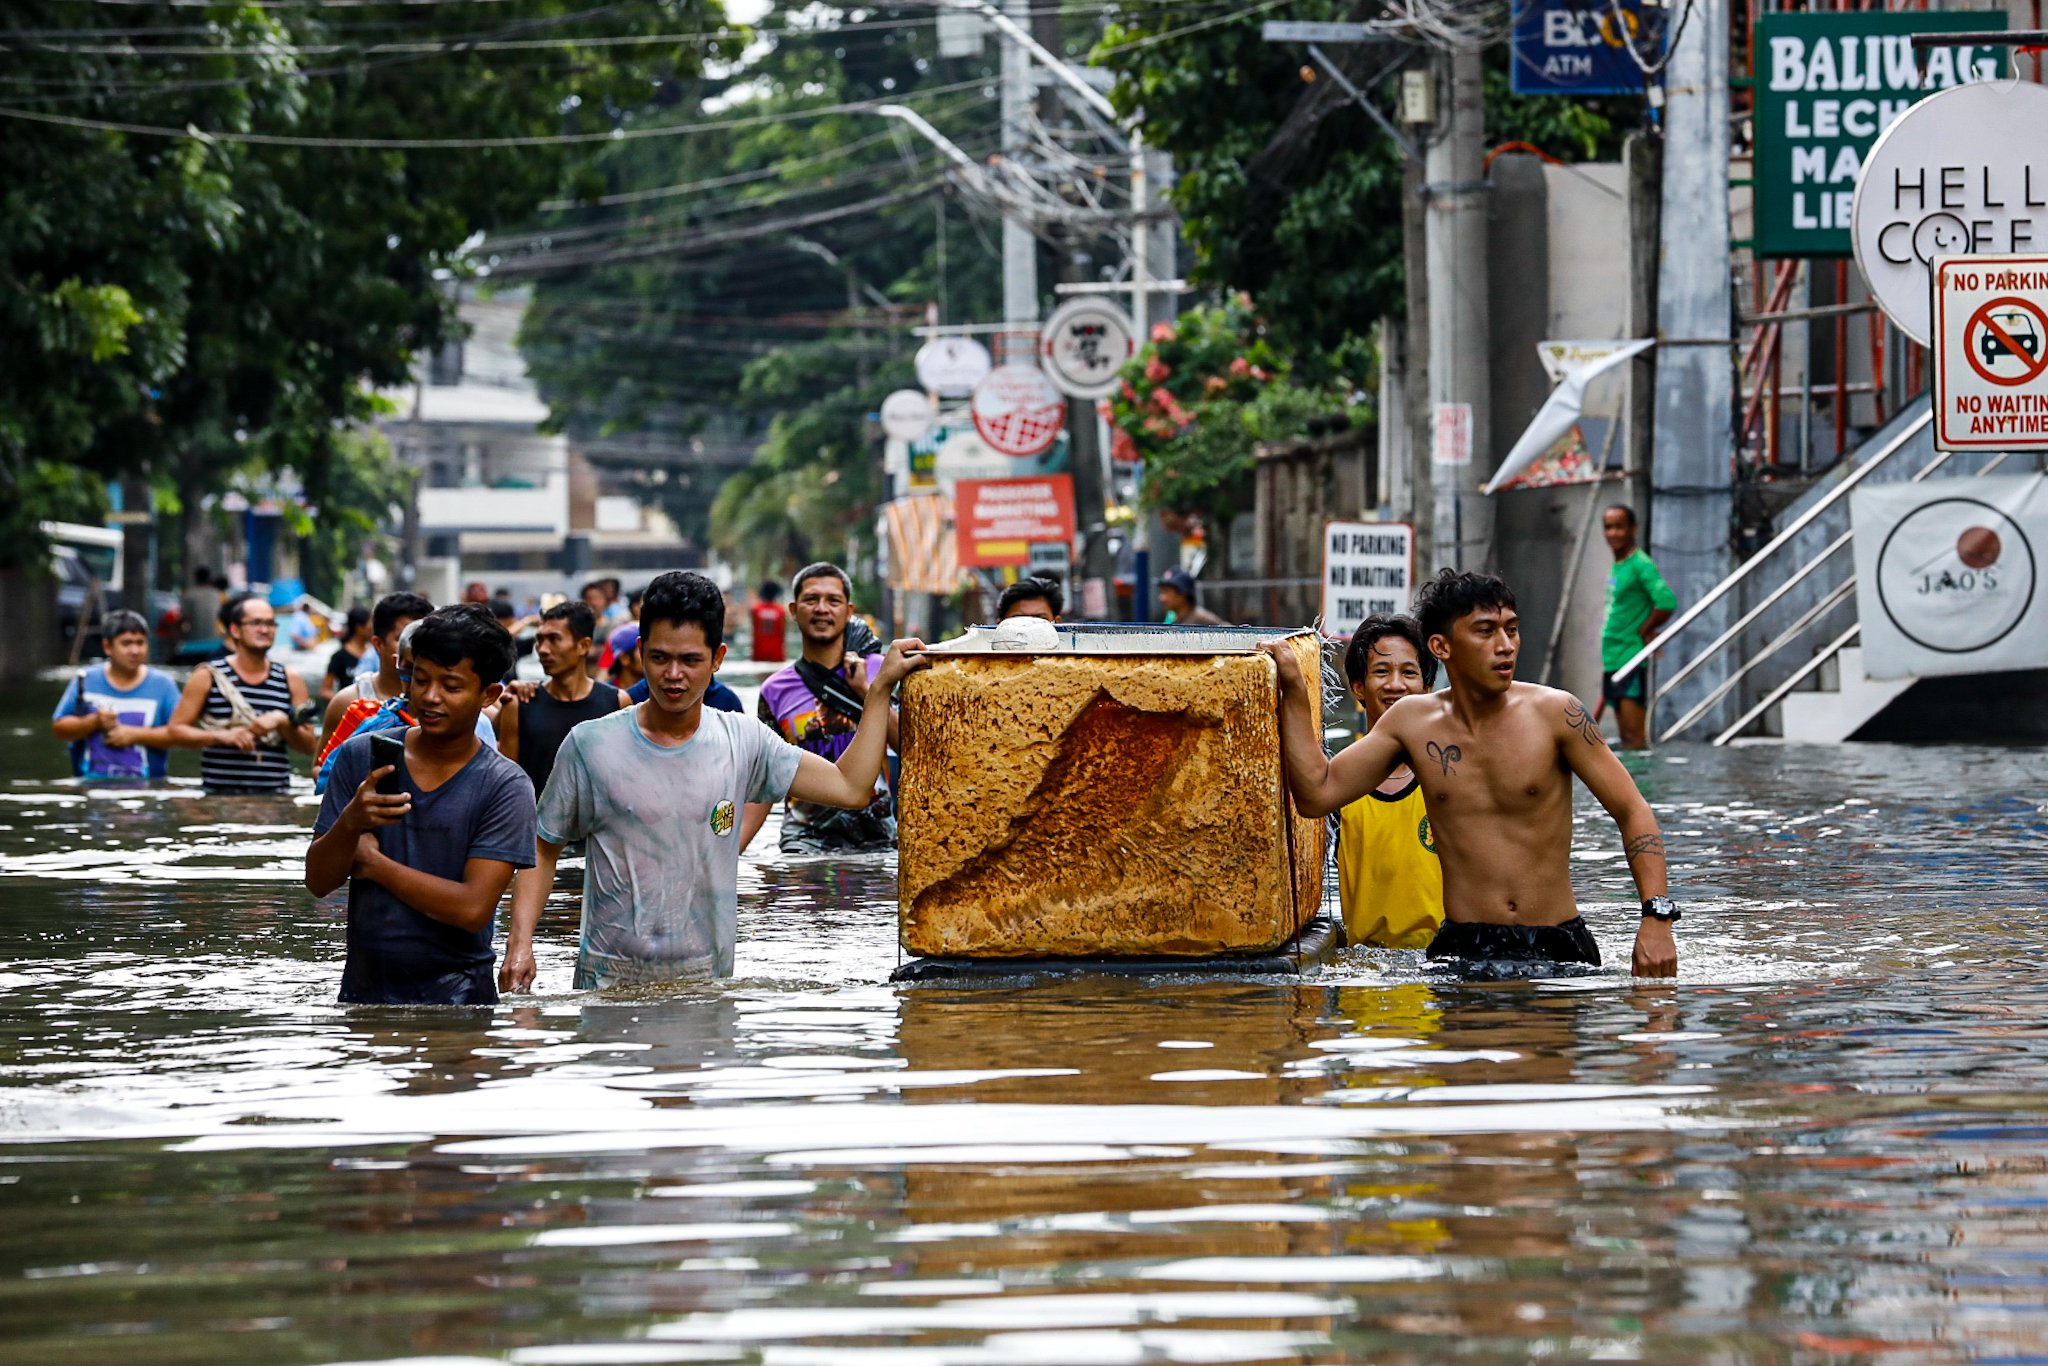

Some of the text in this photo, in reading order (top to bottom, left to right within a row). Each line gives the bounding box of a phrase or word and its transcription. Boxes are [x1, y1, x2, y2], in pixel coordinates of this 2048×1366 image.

[1544, 9, 1639, 48] BDO
[1543, 54, 1593, 76] ATM
[1769, 36, 1998, 91] BALIWAG
[1954, 273, 1979, 291] NO
[1957, 396, 1982, 414] NO
[1970, 415, 2048, 434] ANYTIME
[1332, 534, 1405, 555] NO PARKING
[1331, 566, 1404, 588] NO WAITING
[1917, 570, 1997, 594] JAO'S
[1338, 599, 1364, 619] THIS
